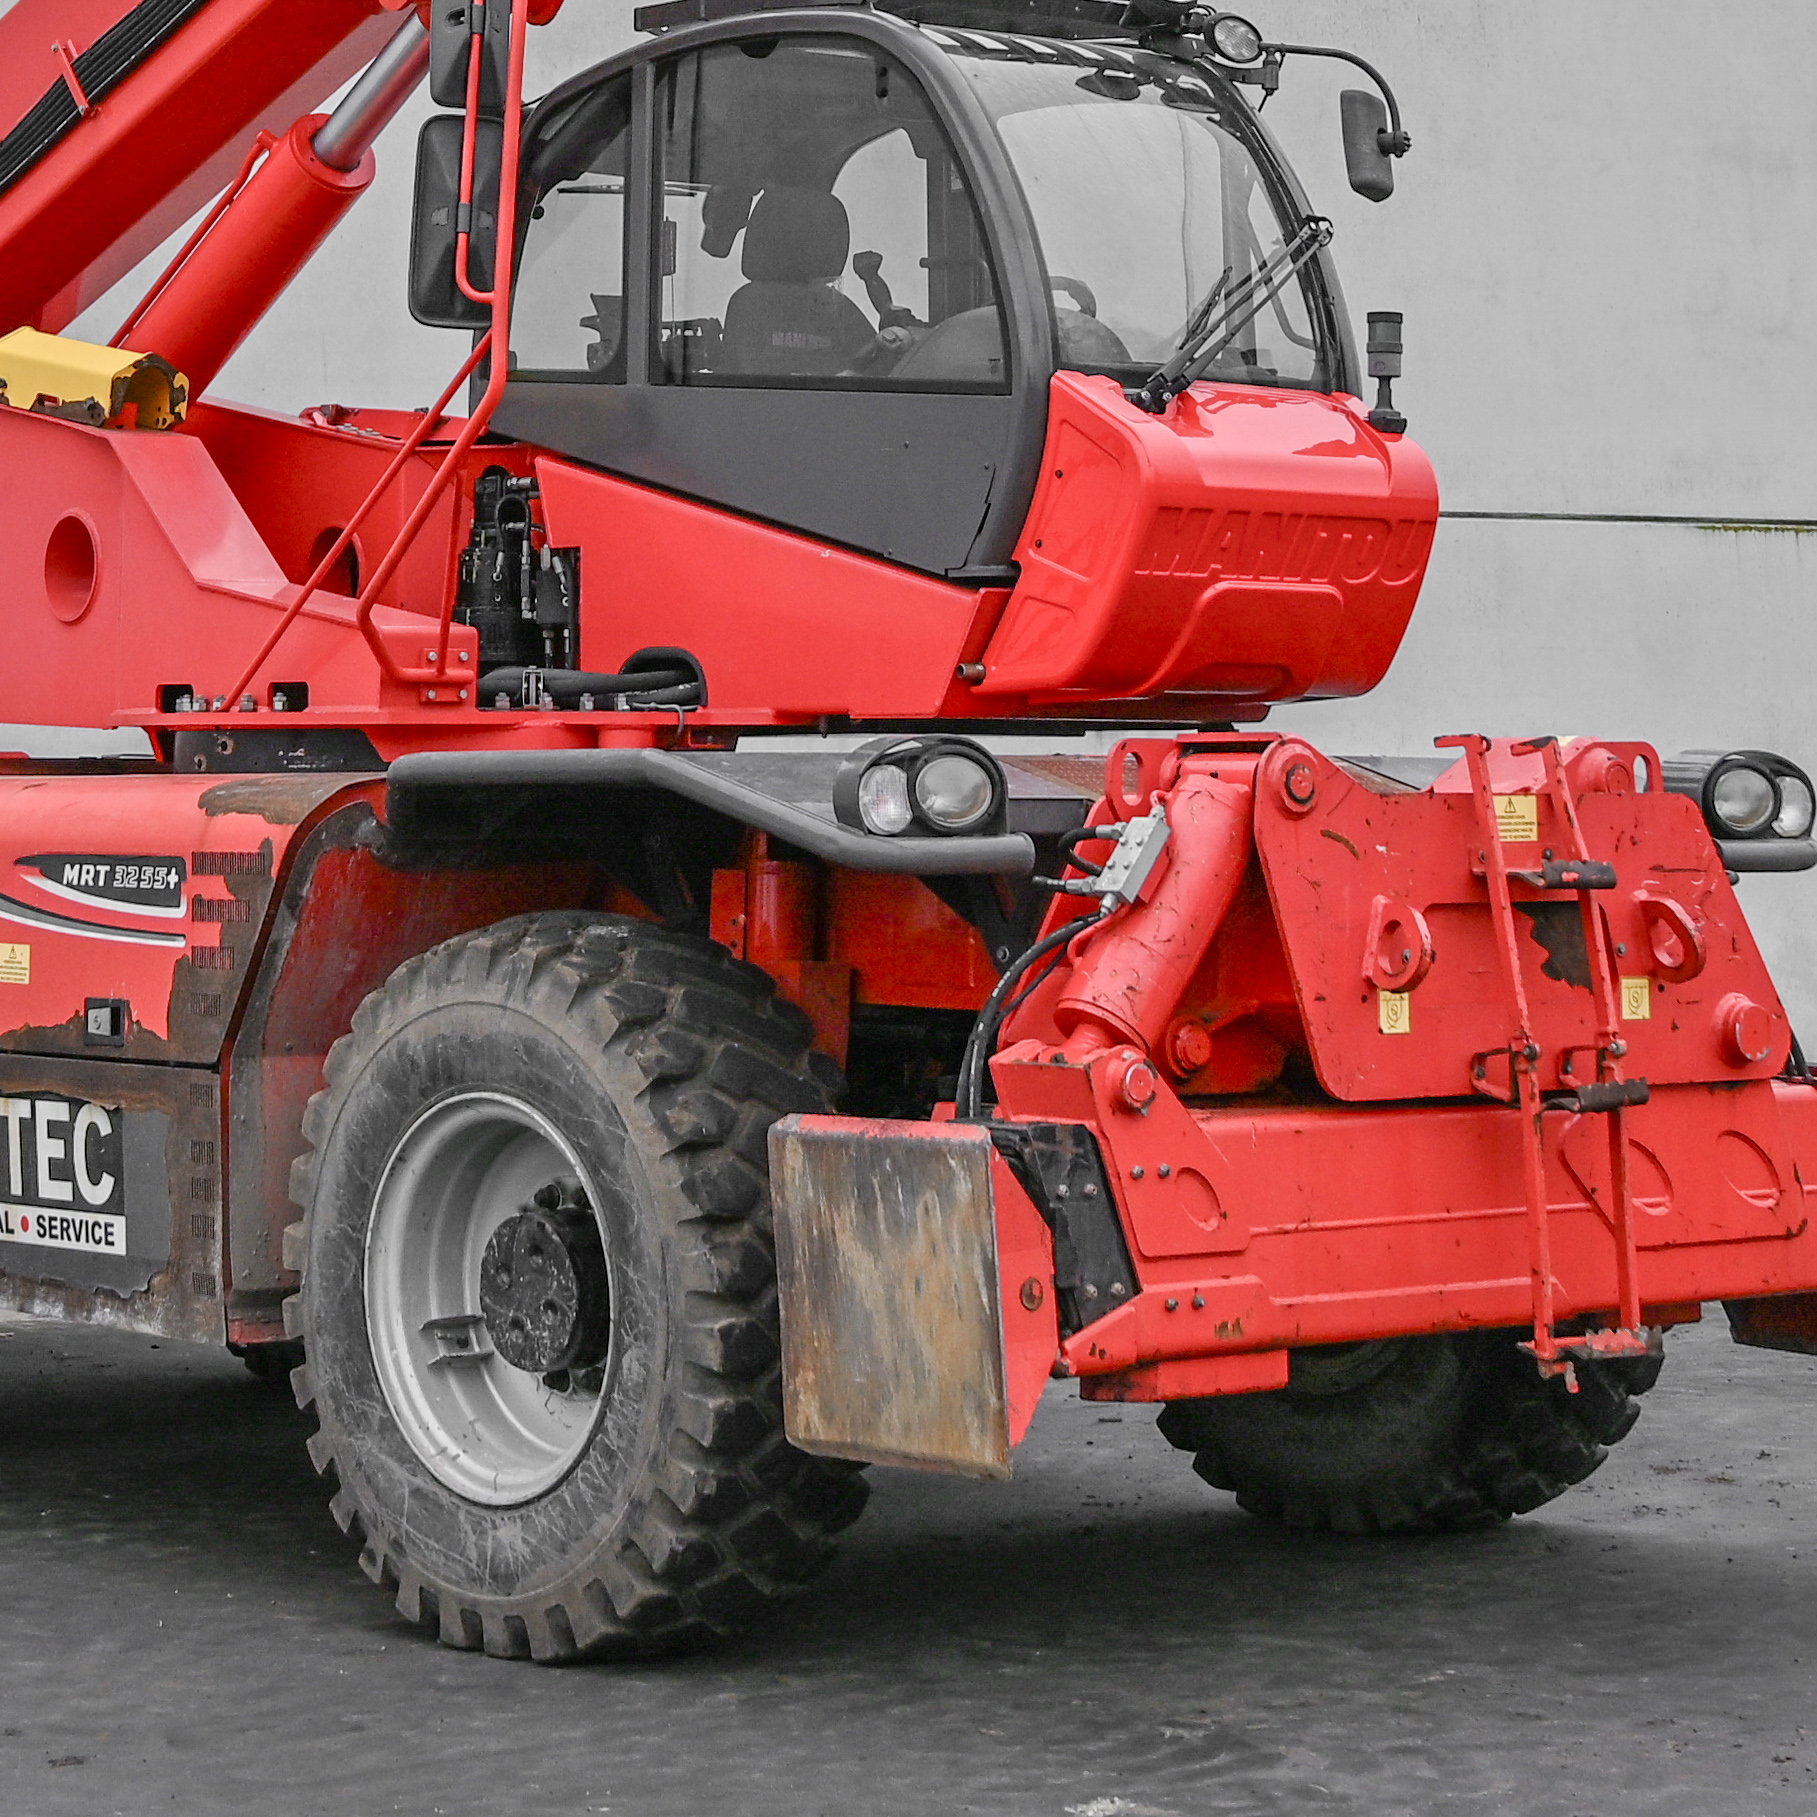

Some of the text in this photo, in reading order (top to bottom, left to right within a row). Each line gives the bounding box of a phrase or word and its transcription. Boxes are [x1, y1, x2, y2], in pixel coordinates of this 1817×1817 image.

[1133, 505, 1436, 586] MANITOU
[63, 863, 180, 890] MRT 3255+
[35, 1213, 116, 1247] SERVICE
